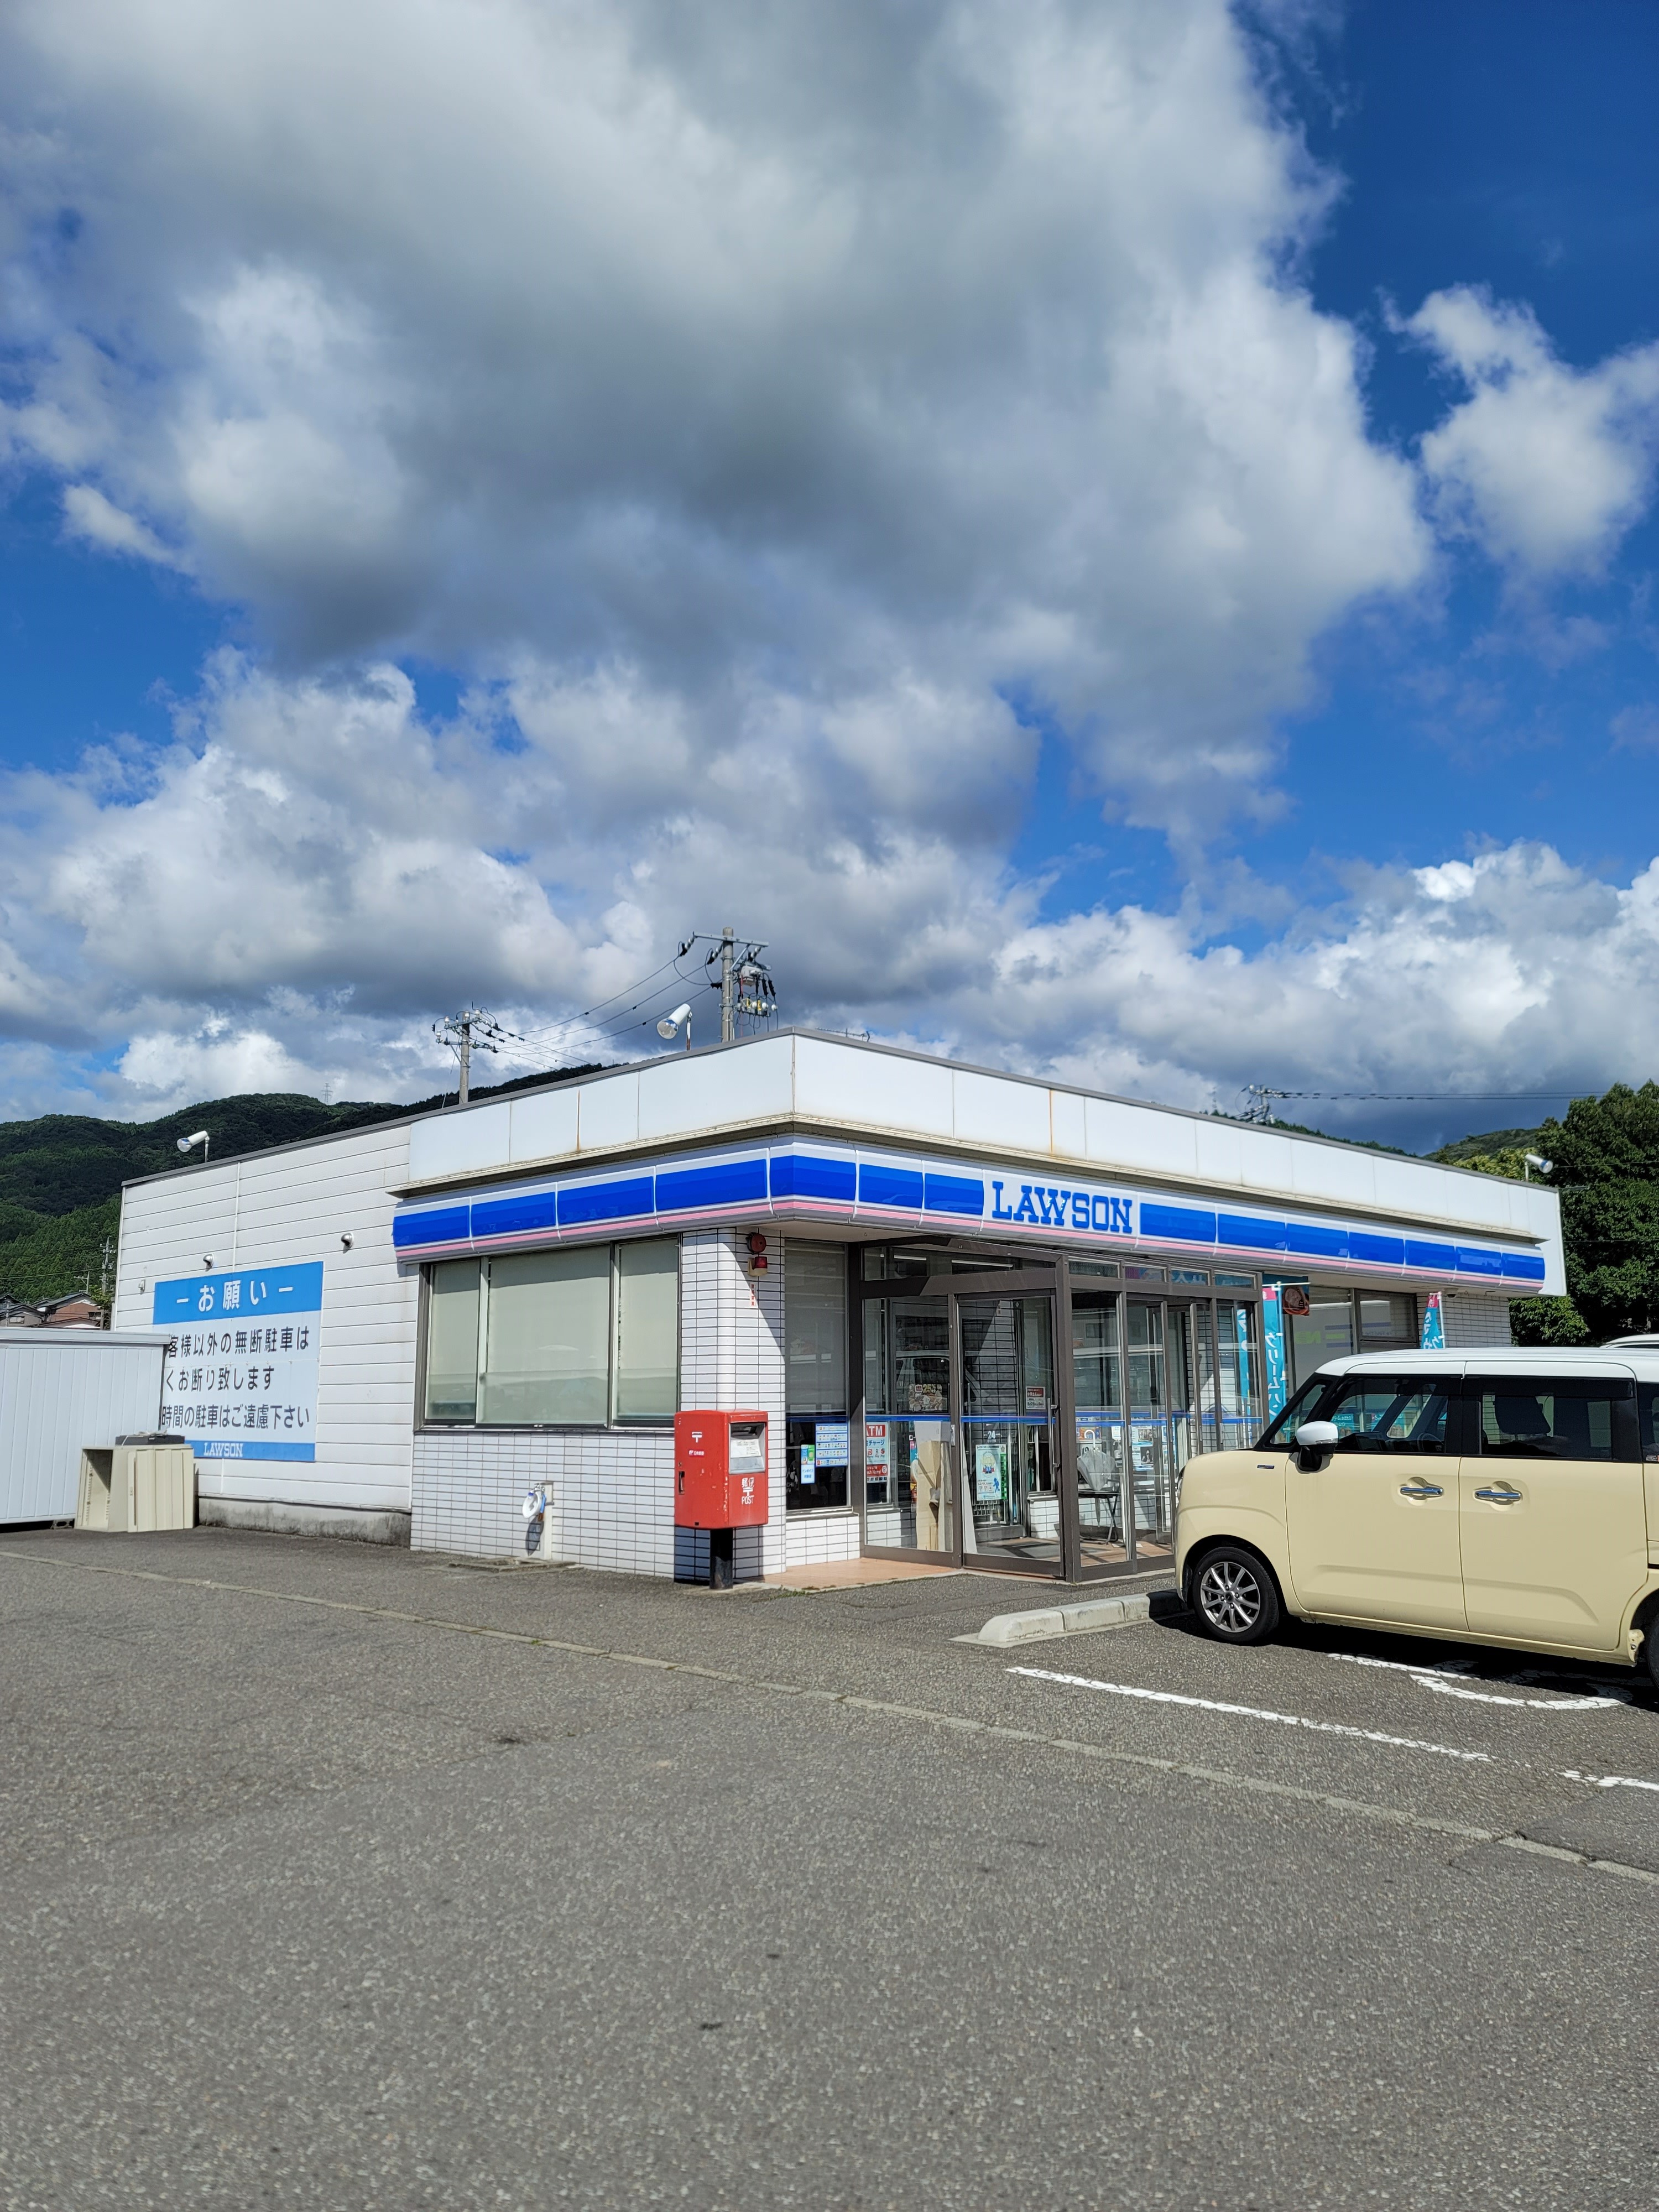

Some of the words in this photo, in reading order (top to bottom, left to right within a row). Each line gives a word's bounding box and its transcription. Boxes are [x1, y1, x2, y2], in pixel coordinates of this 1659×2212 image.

[992, 1181, 1132, 1234] LAWSON
[166, 1365, 275, 1392] くお断り致します
[161, 1404, 310, 1430] 時間の駐車はご遠慮下さい
[987, 1431, 996, 1439] 24
[204, 1442, 244, 1458] LAWSON
[741, 1495, 755, 1505] POST
